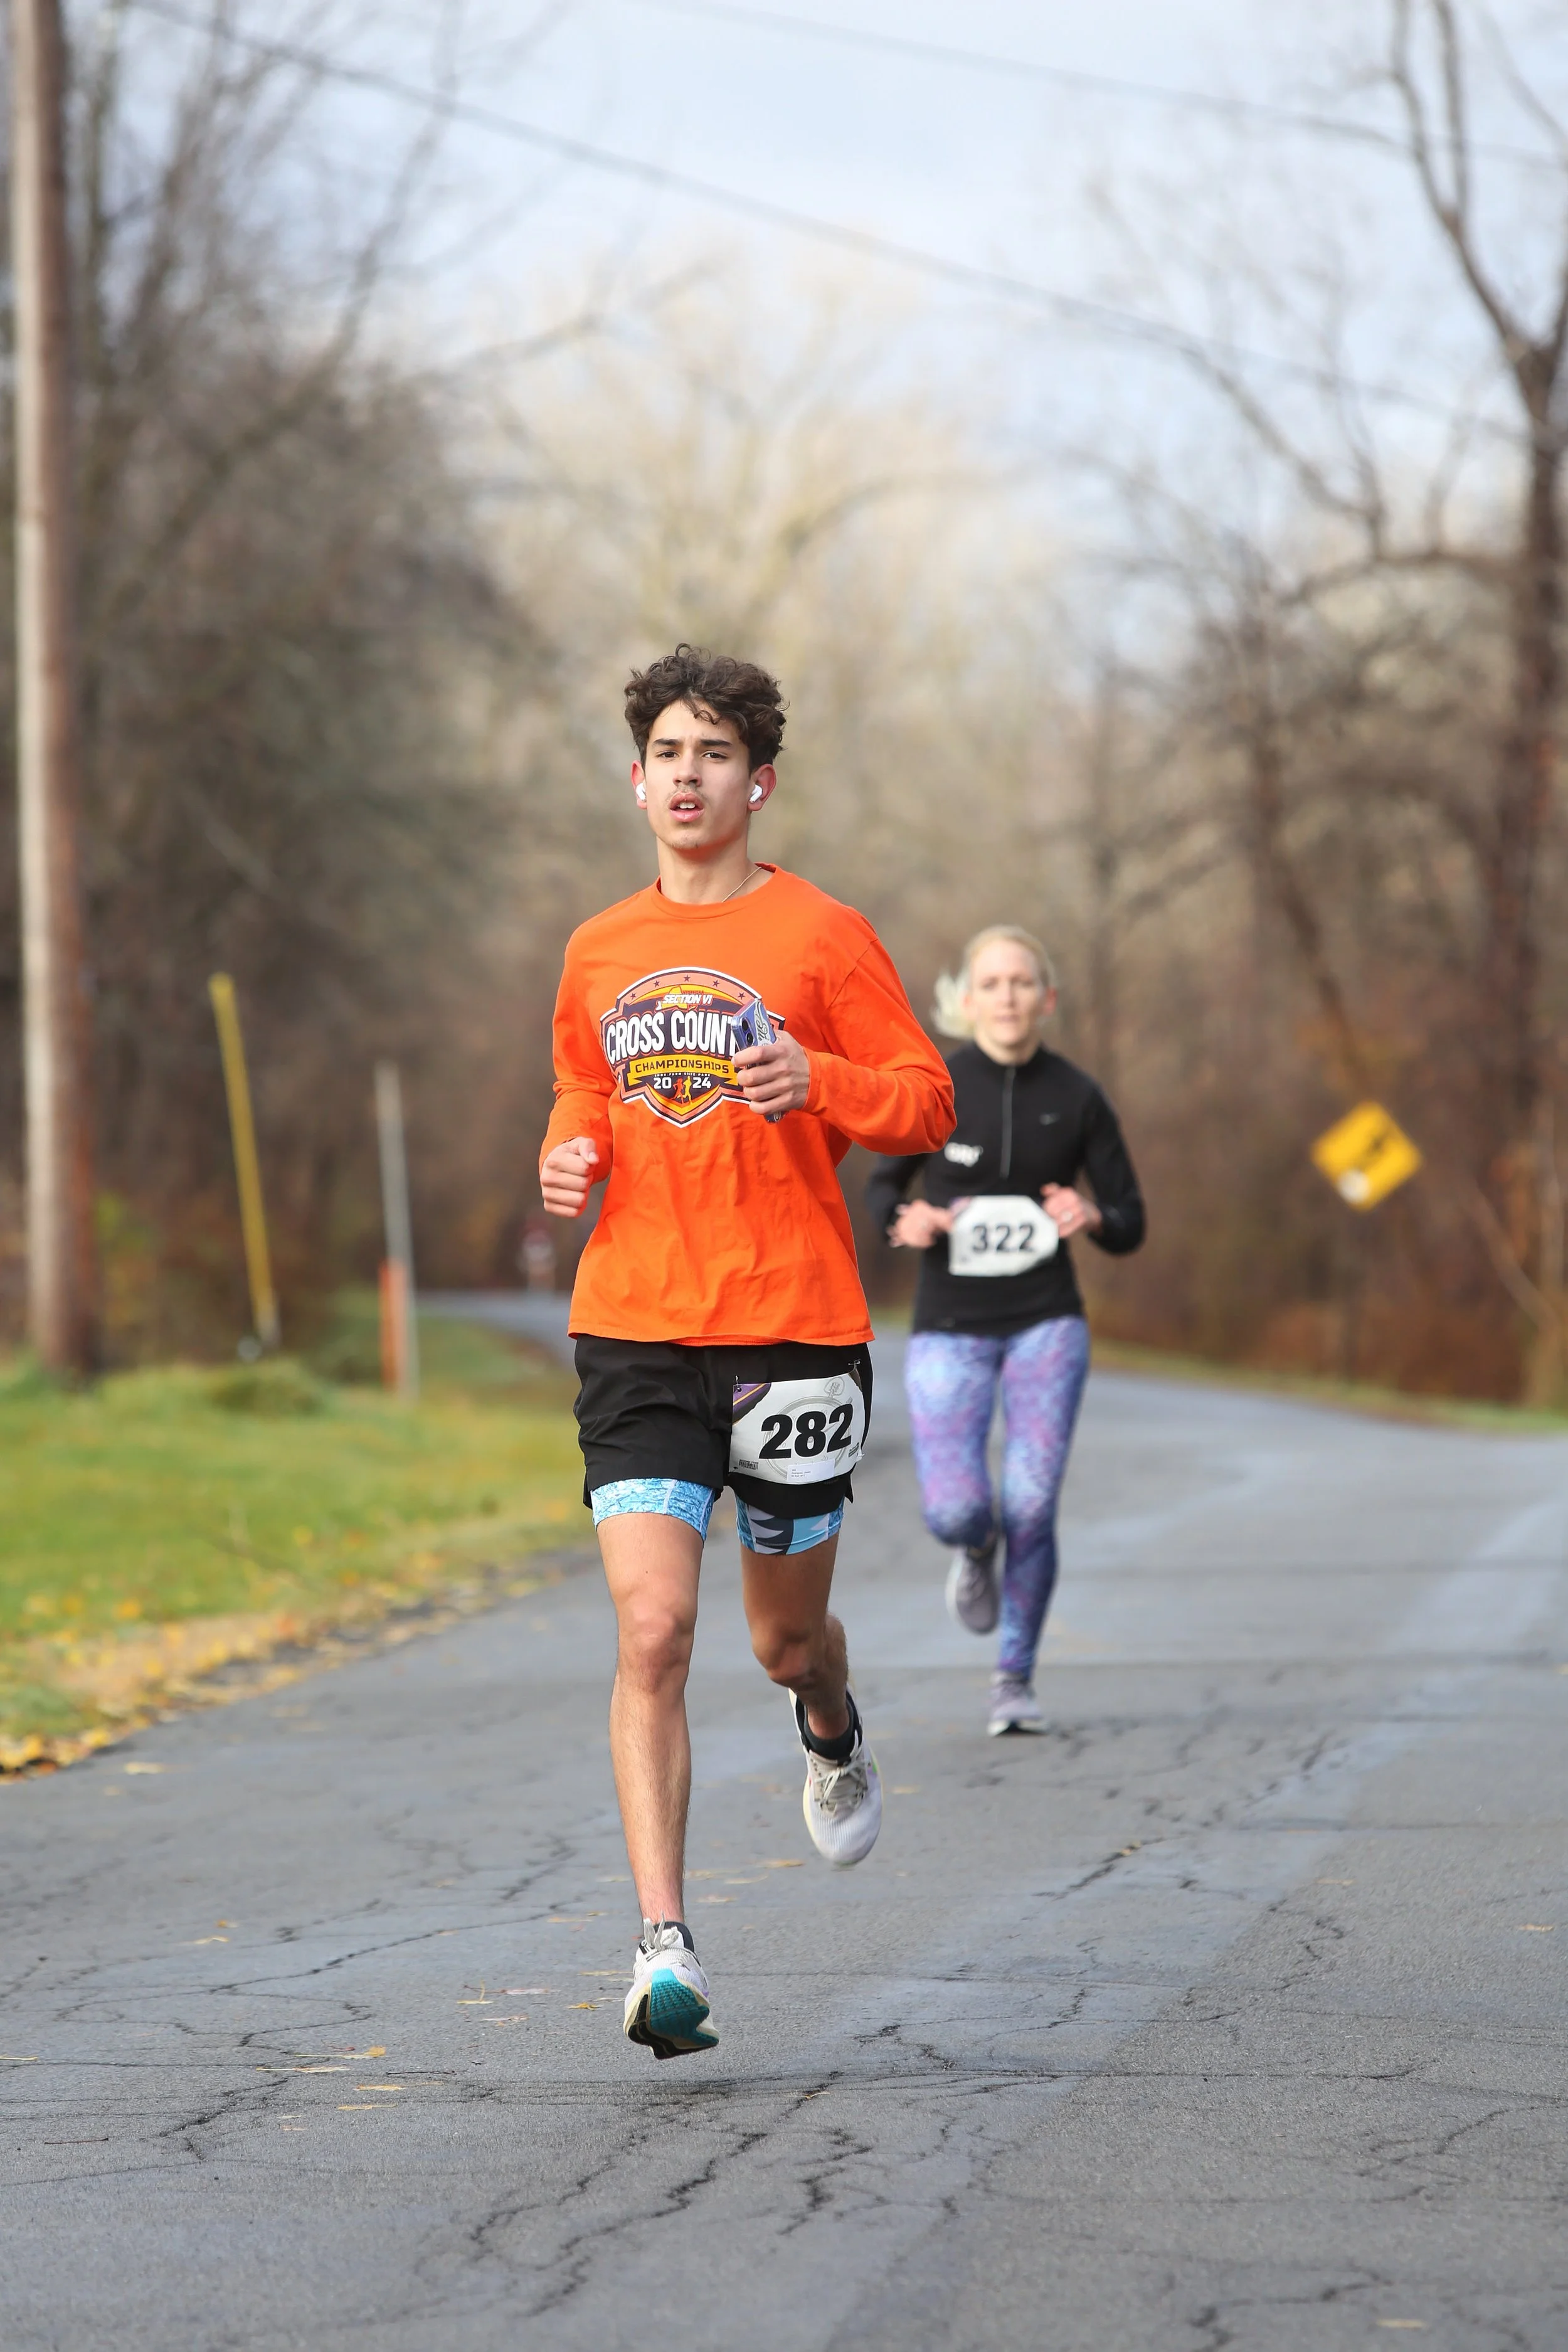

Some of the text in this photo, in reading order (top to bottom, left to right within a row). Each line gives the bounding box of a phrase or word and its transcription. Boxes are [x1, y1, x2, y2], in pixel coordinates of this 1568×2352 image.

[662, 994, 713, 1004] SECTION VI
[607, 1012, 665, 1065] CROSS
[670, 1010, 736, 1057] COUNT
[635, 1059, 729, 1074] CHAMPIONSHIPS
[654, 1077, 712, 1089] 20 24
[973, 1224, 1034, 1252] 322
[759, 1404, 853, 1459] 282
